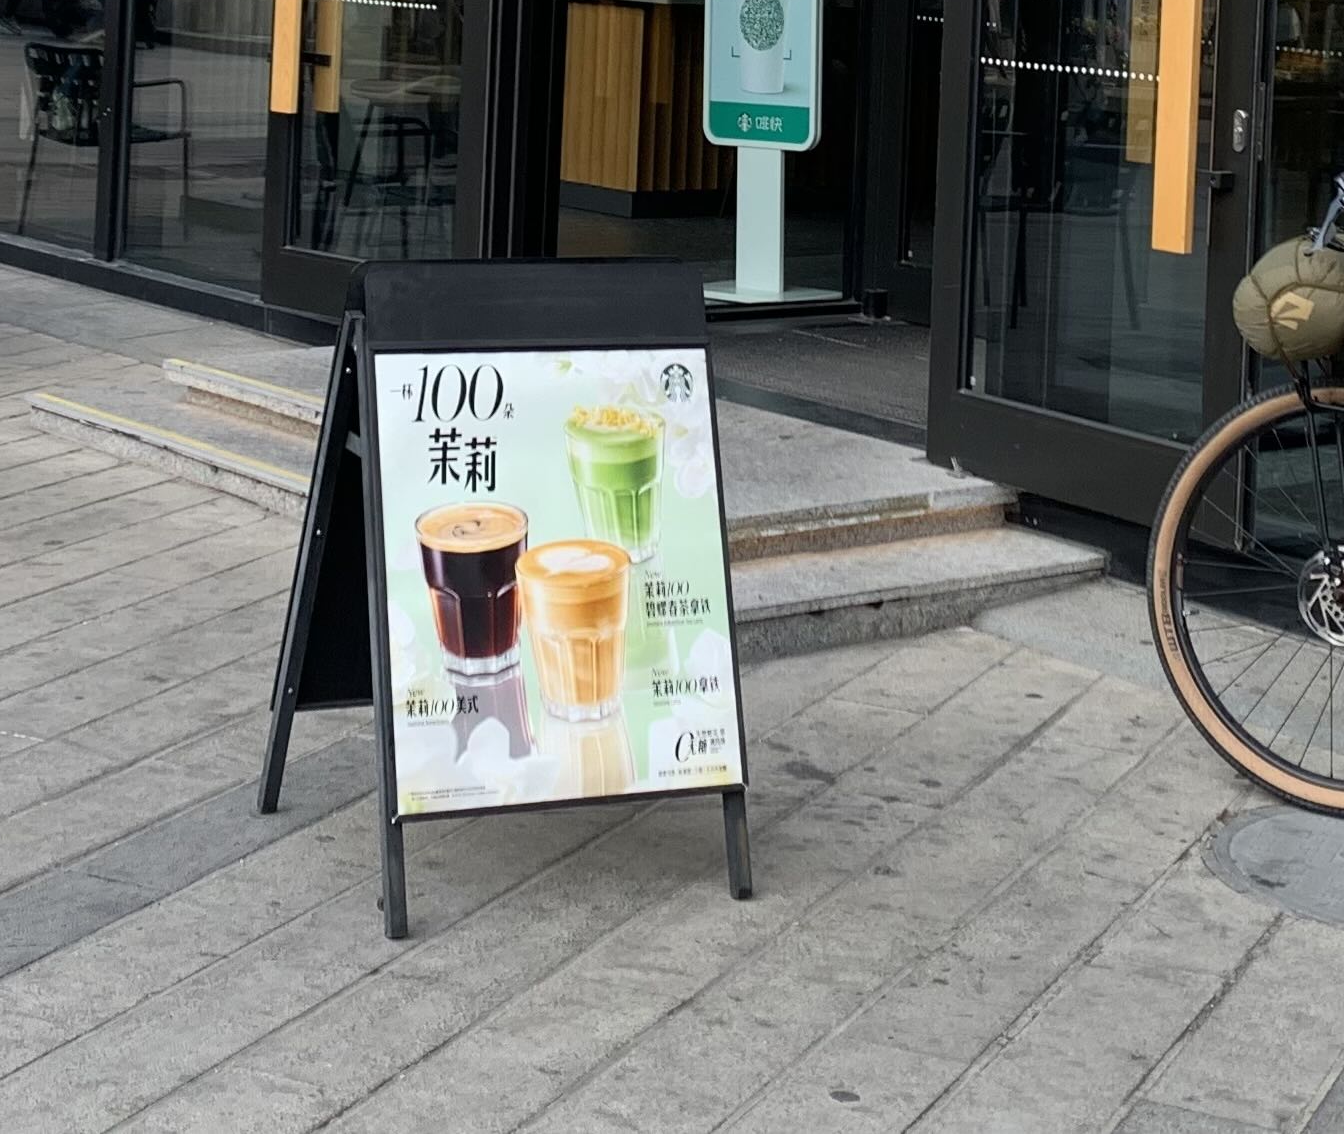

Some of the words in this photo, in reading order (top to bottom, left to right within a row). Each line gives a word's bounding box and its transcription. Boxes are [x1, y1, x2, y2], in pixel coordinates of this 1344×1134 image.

[427, 427, 498, 494] 茉莉
[645, 581, 690, 599] 茉莉100
[406, 694, 479, 718] 茉莉100美式
